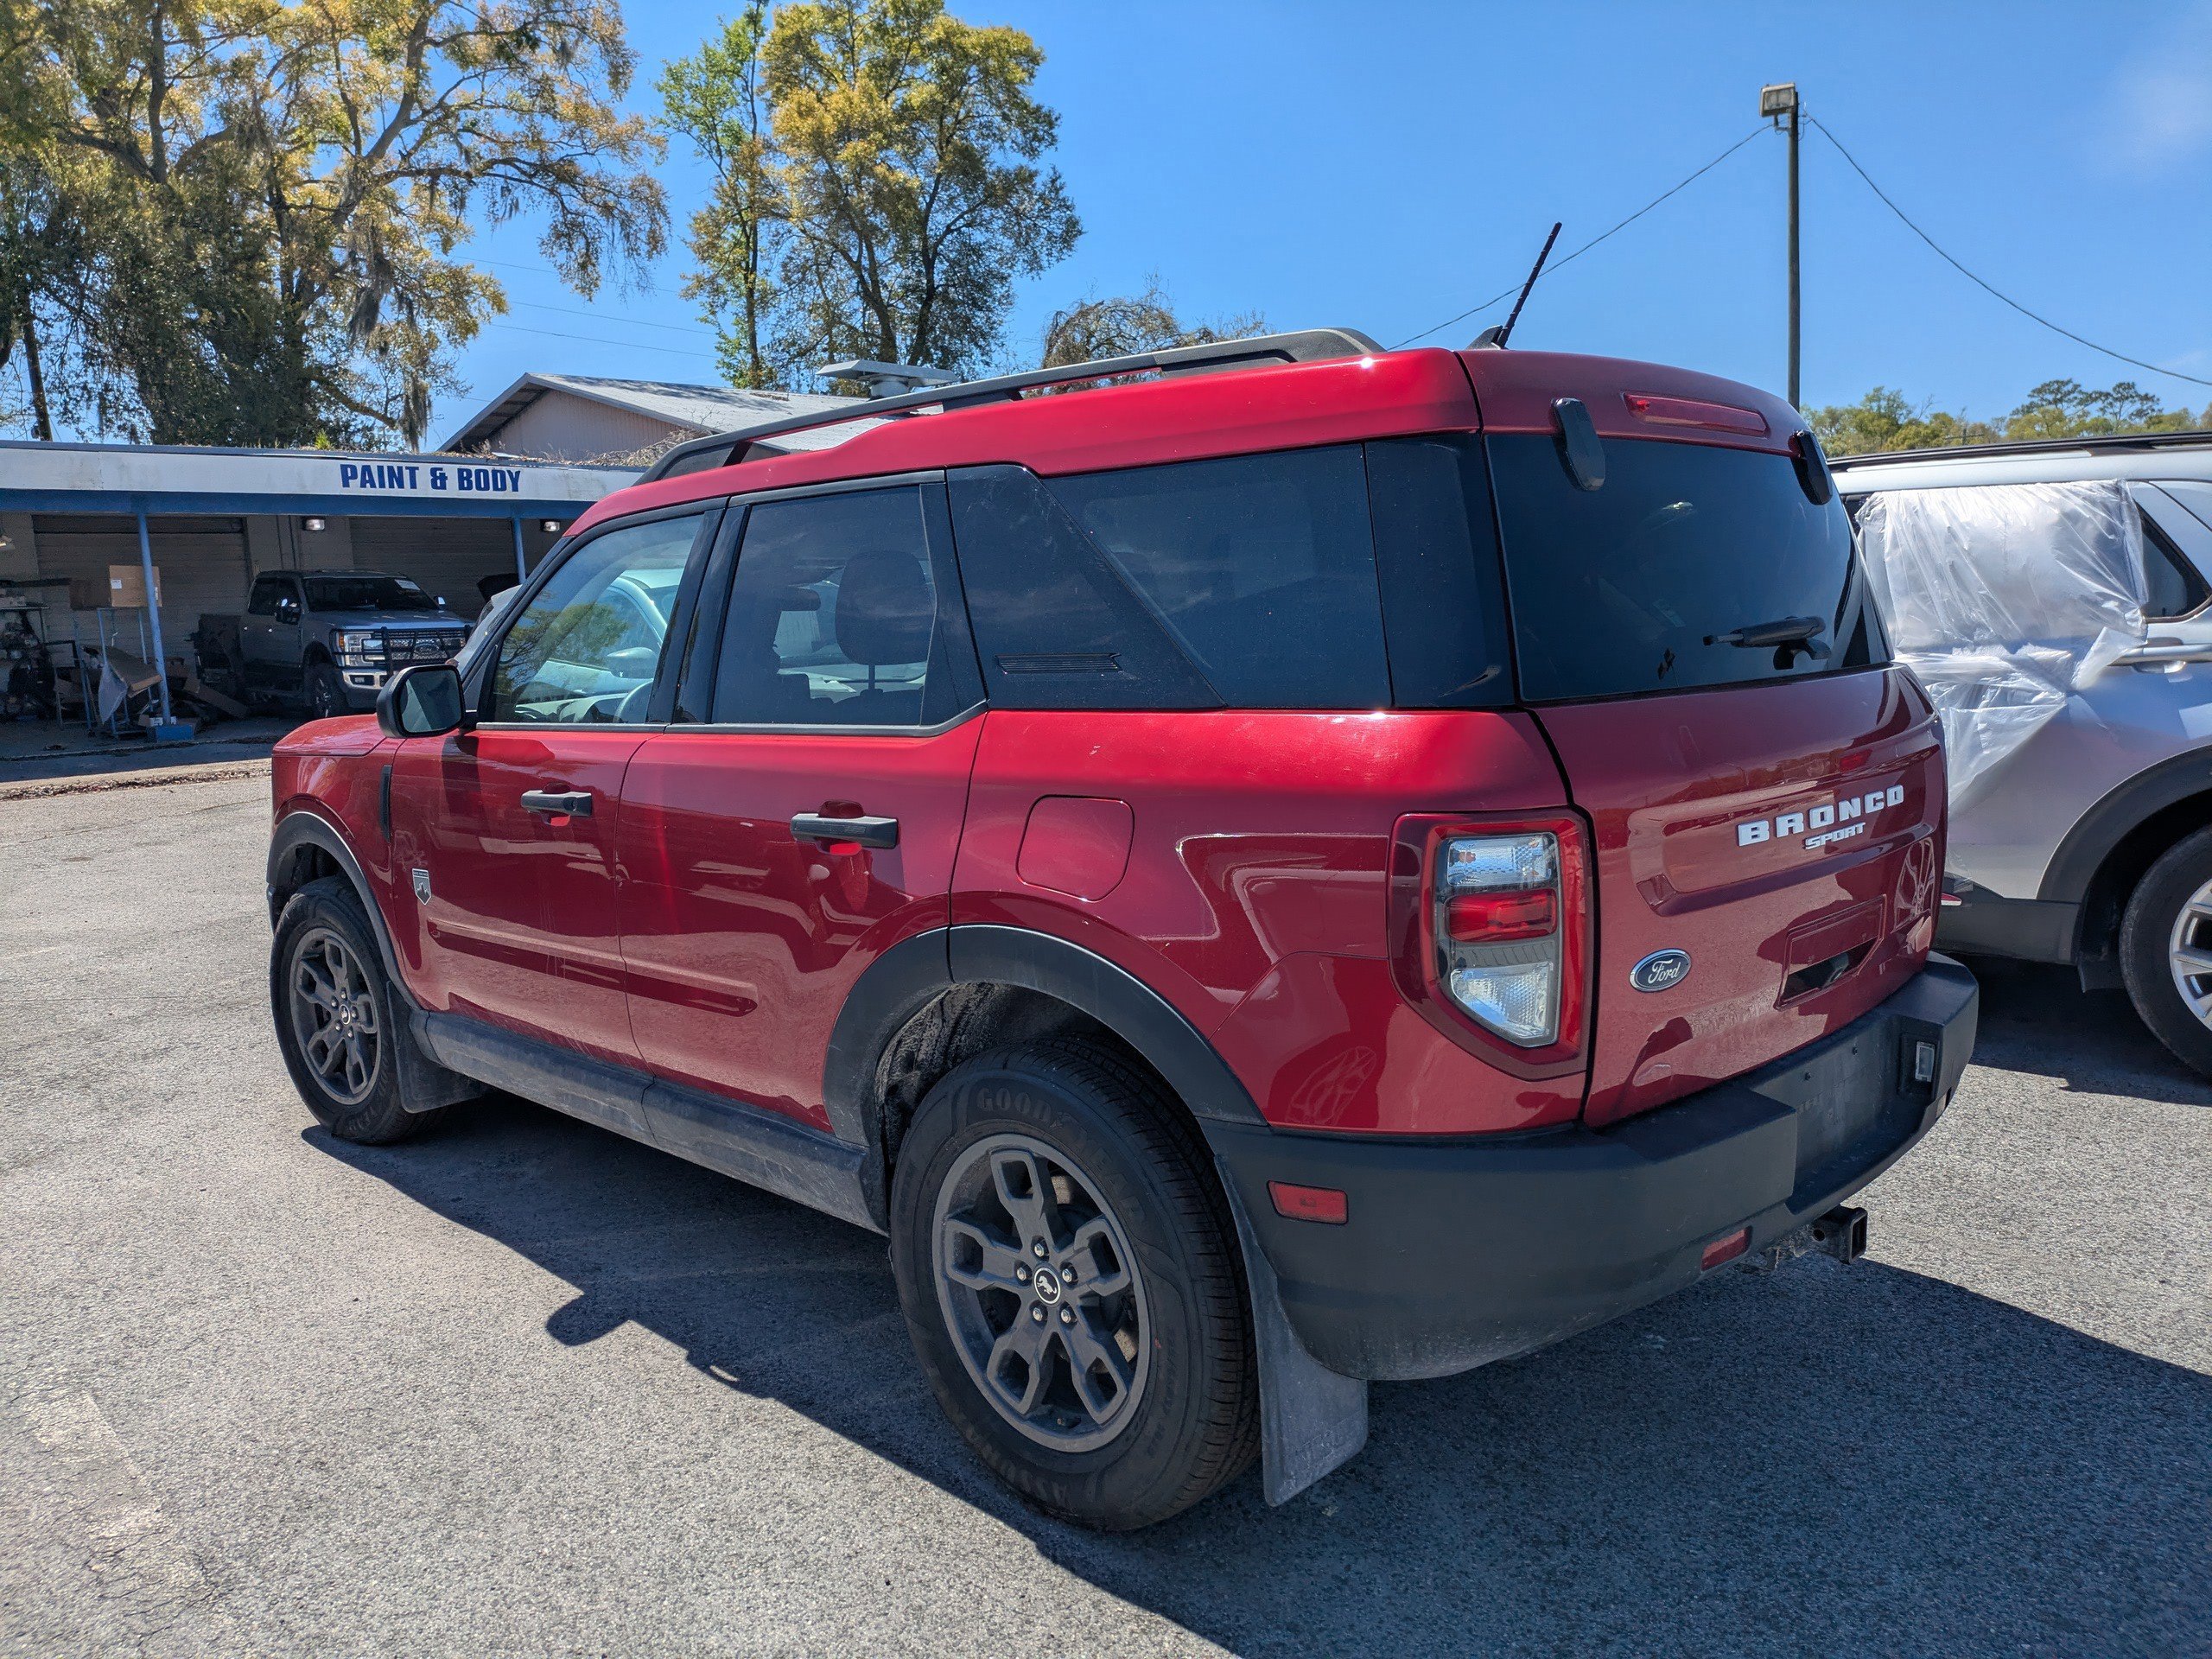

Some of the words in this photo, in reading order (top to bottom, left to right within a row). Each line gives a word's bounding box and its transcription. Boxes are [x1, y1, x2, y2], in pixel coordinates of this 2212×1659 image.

[340, 463, 419, 489] PAINT
[429, 467, 448, 491] &
[457, 467, 521, 493] BODY
[1737, 784, 1904, 847] BRONCO
[1803, 822, 1866, 850] SPORT
[1647, 958, 1681, 984] Ford
